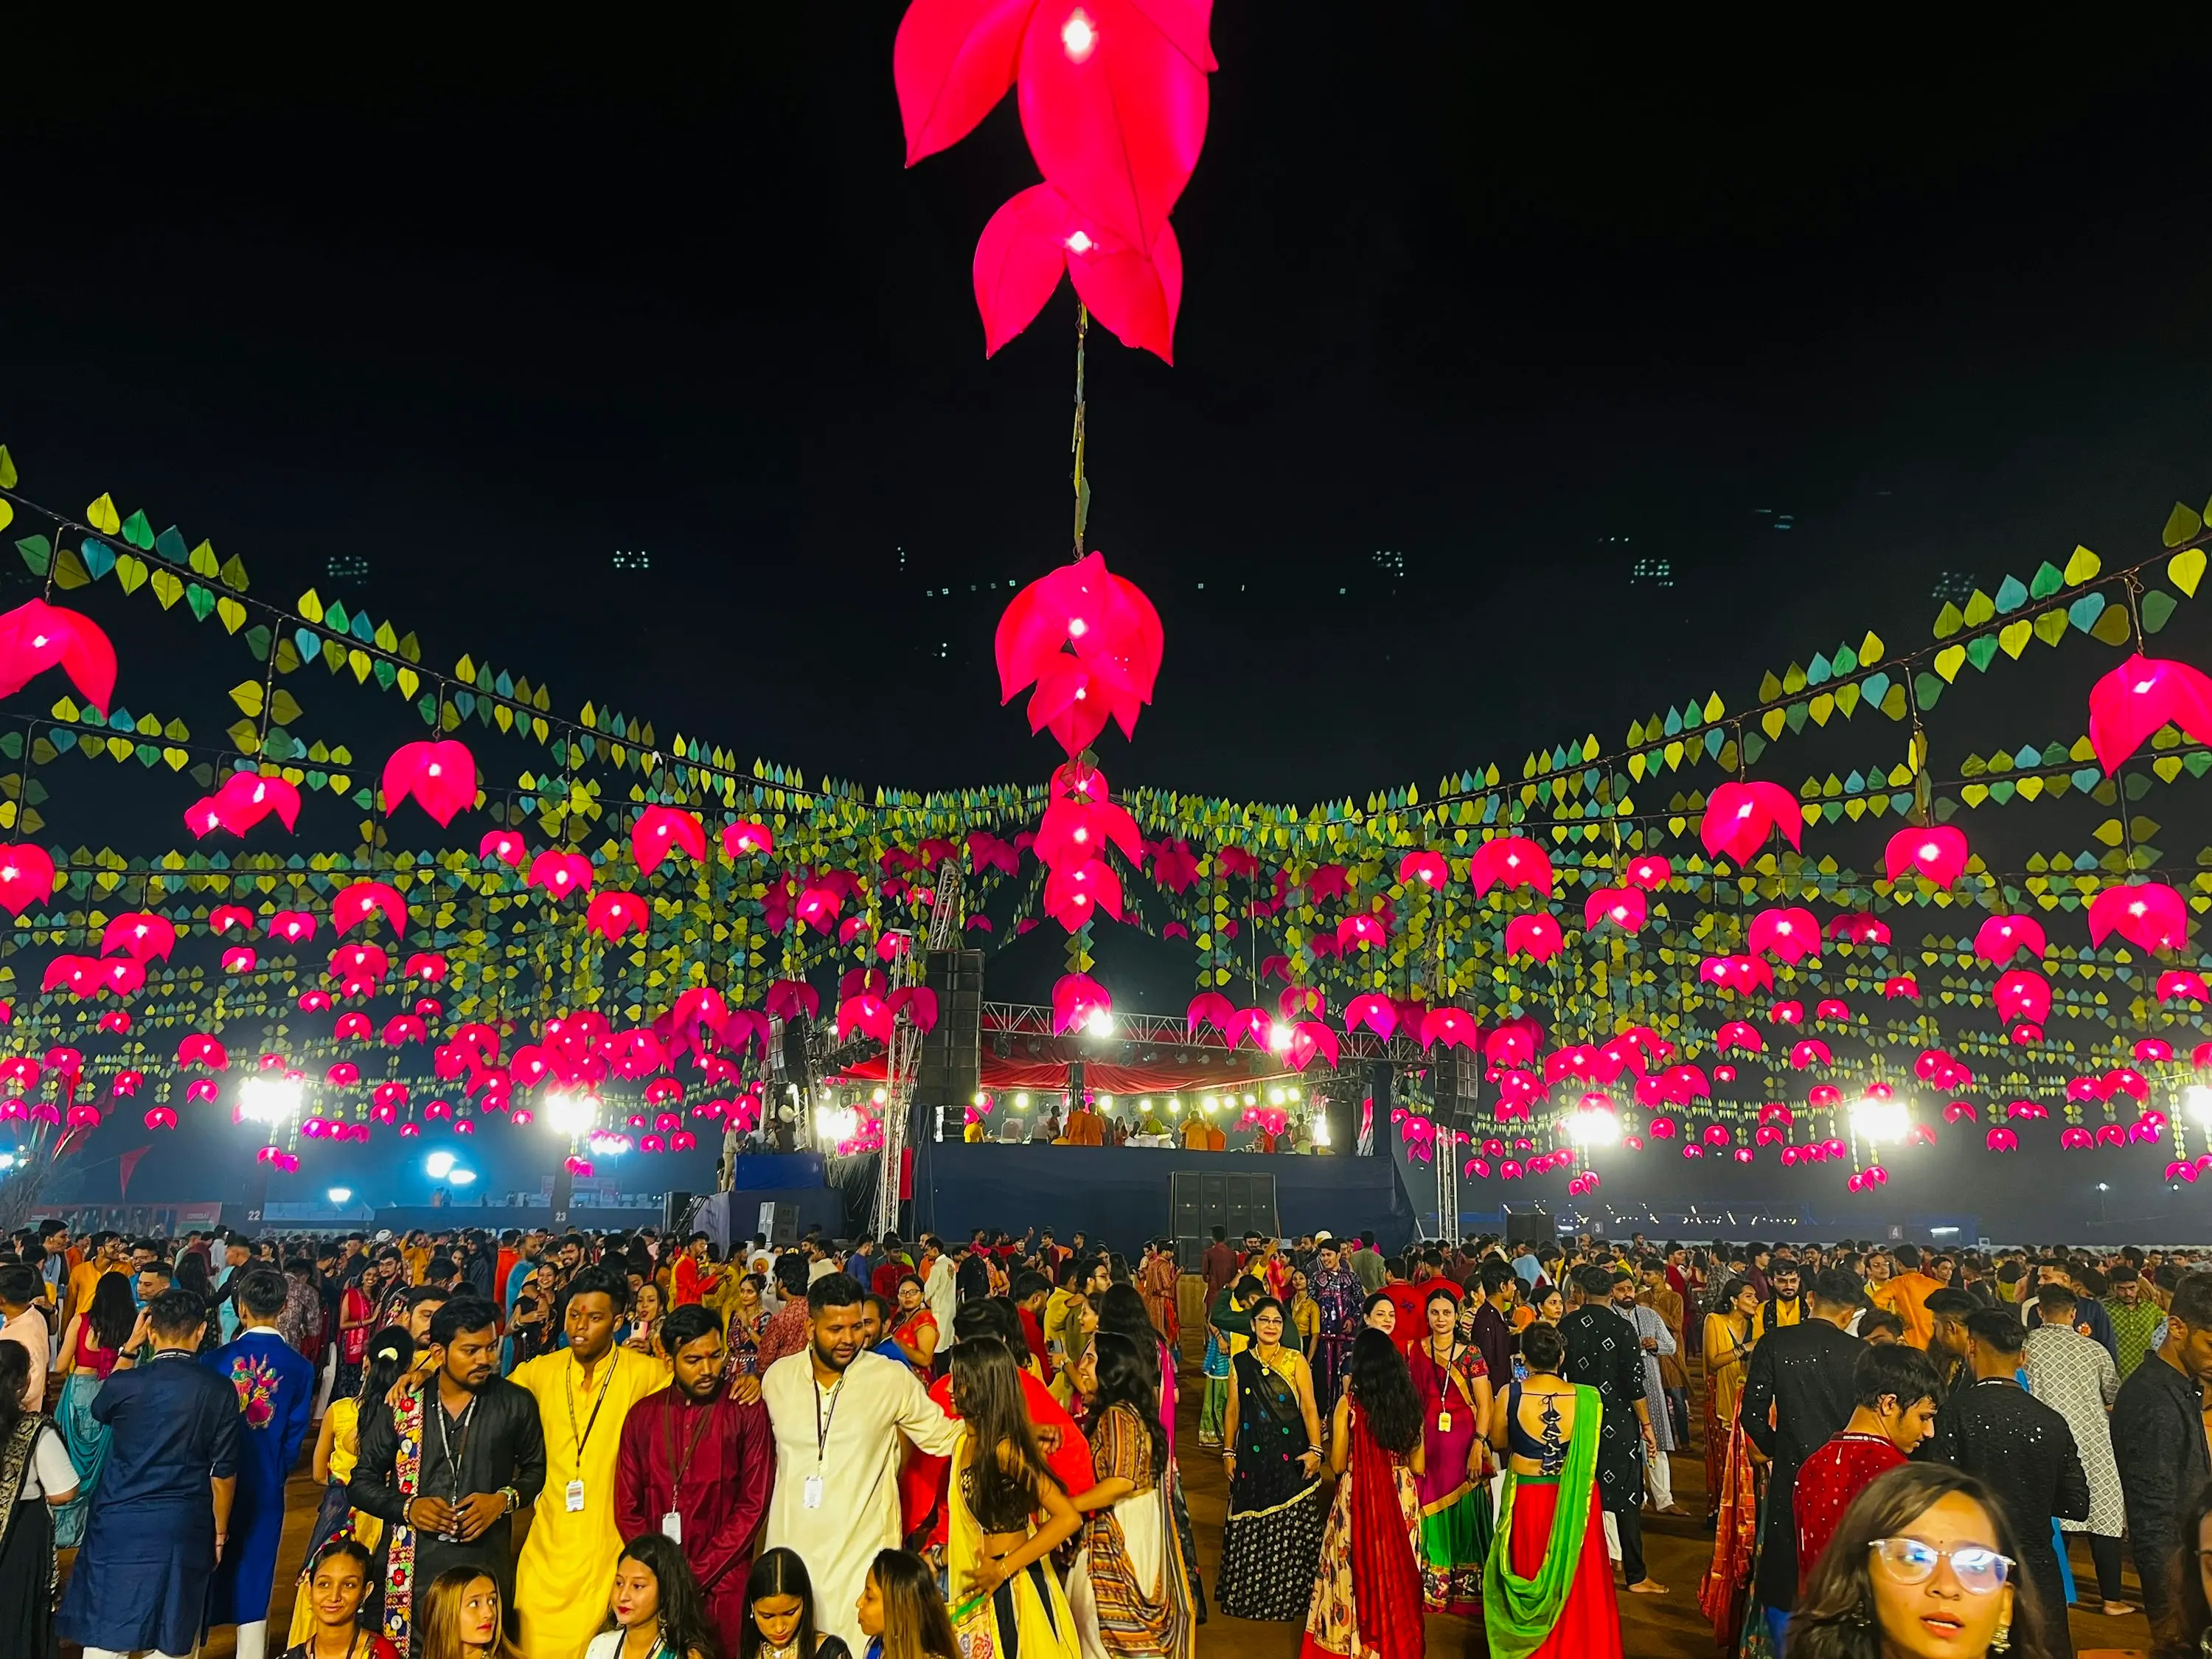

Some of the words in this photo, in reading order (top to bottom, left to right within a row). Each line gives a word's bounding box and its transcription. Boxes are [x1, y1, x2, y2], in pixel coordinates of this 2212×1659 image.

[247, 1210, 260, 1221] 22
[555, 1211, 566, 1222] 23
[1595, 1222, 1601, 1233] 3
